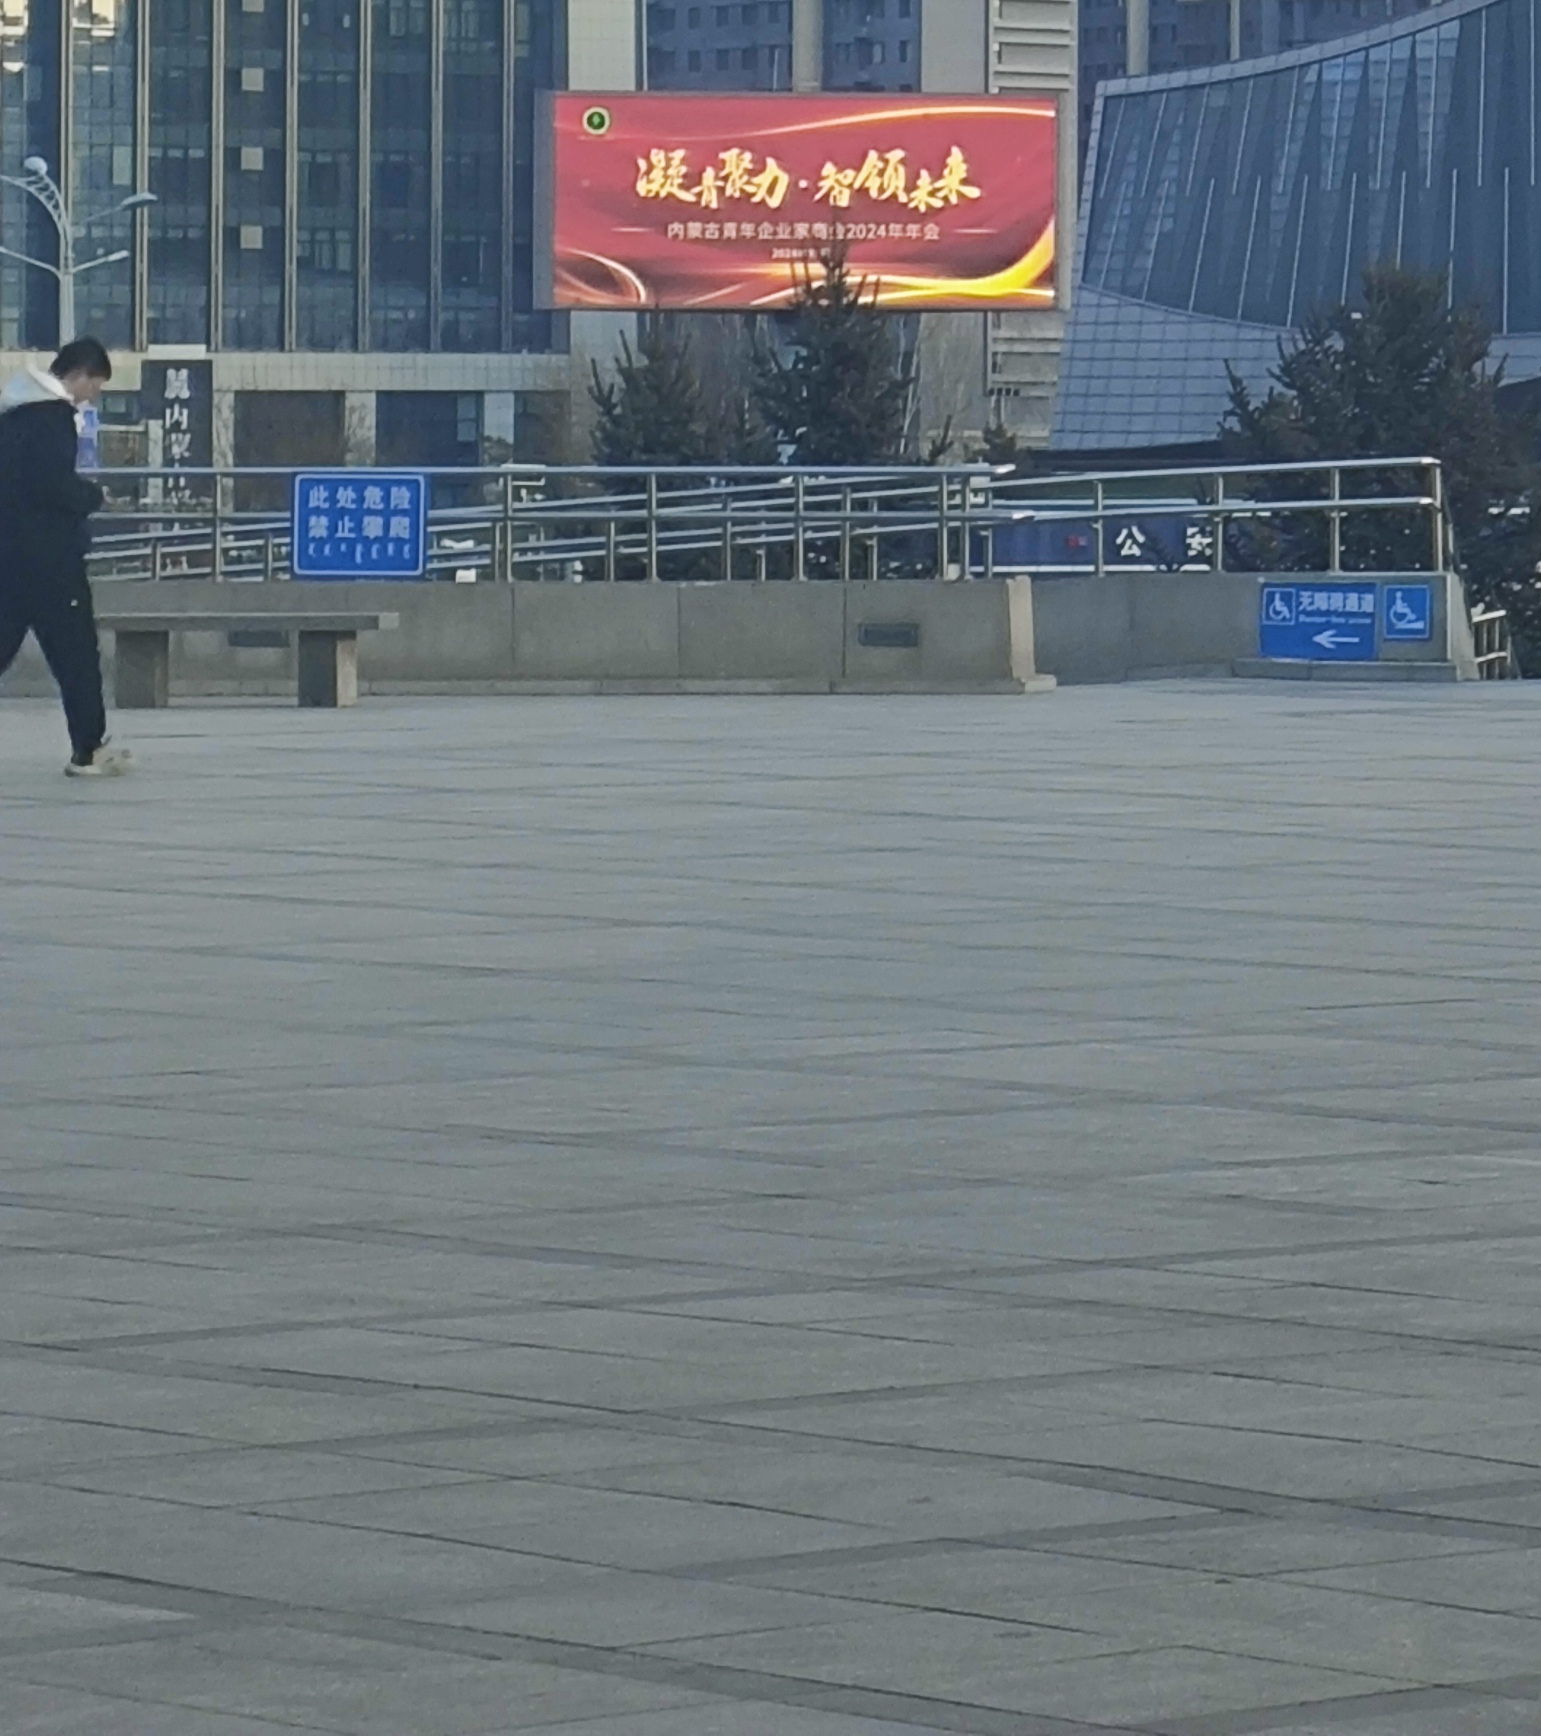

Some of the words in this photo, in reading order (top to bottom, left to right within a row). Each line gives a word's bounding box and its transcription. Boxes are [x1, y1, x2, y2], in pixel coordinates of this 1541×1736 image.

[308, 485, 411, 510] 此处危险
[308, 515, 411, 540] 禁止攀爬
[1298, 590, 1375, 613] 无障碍通道
